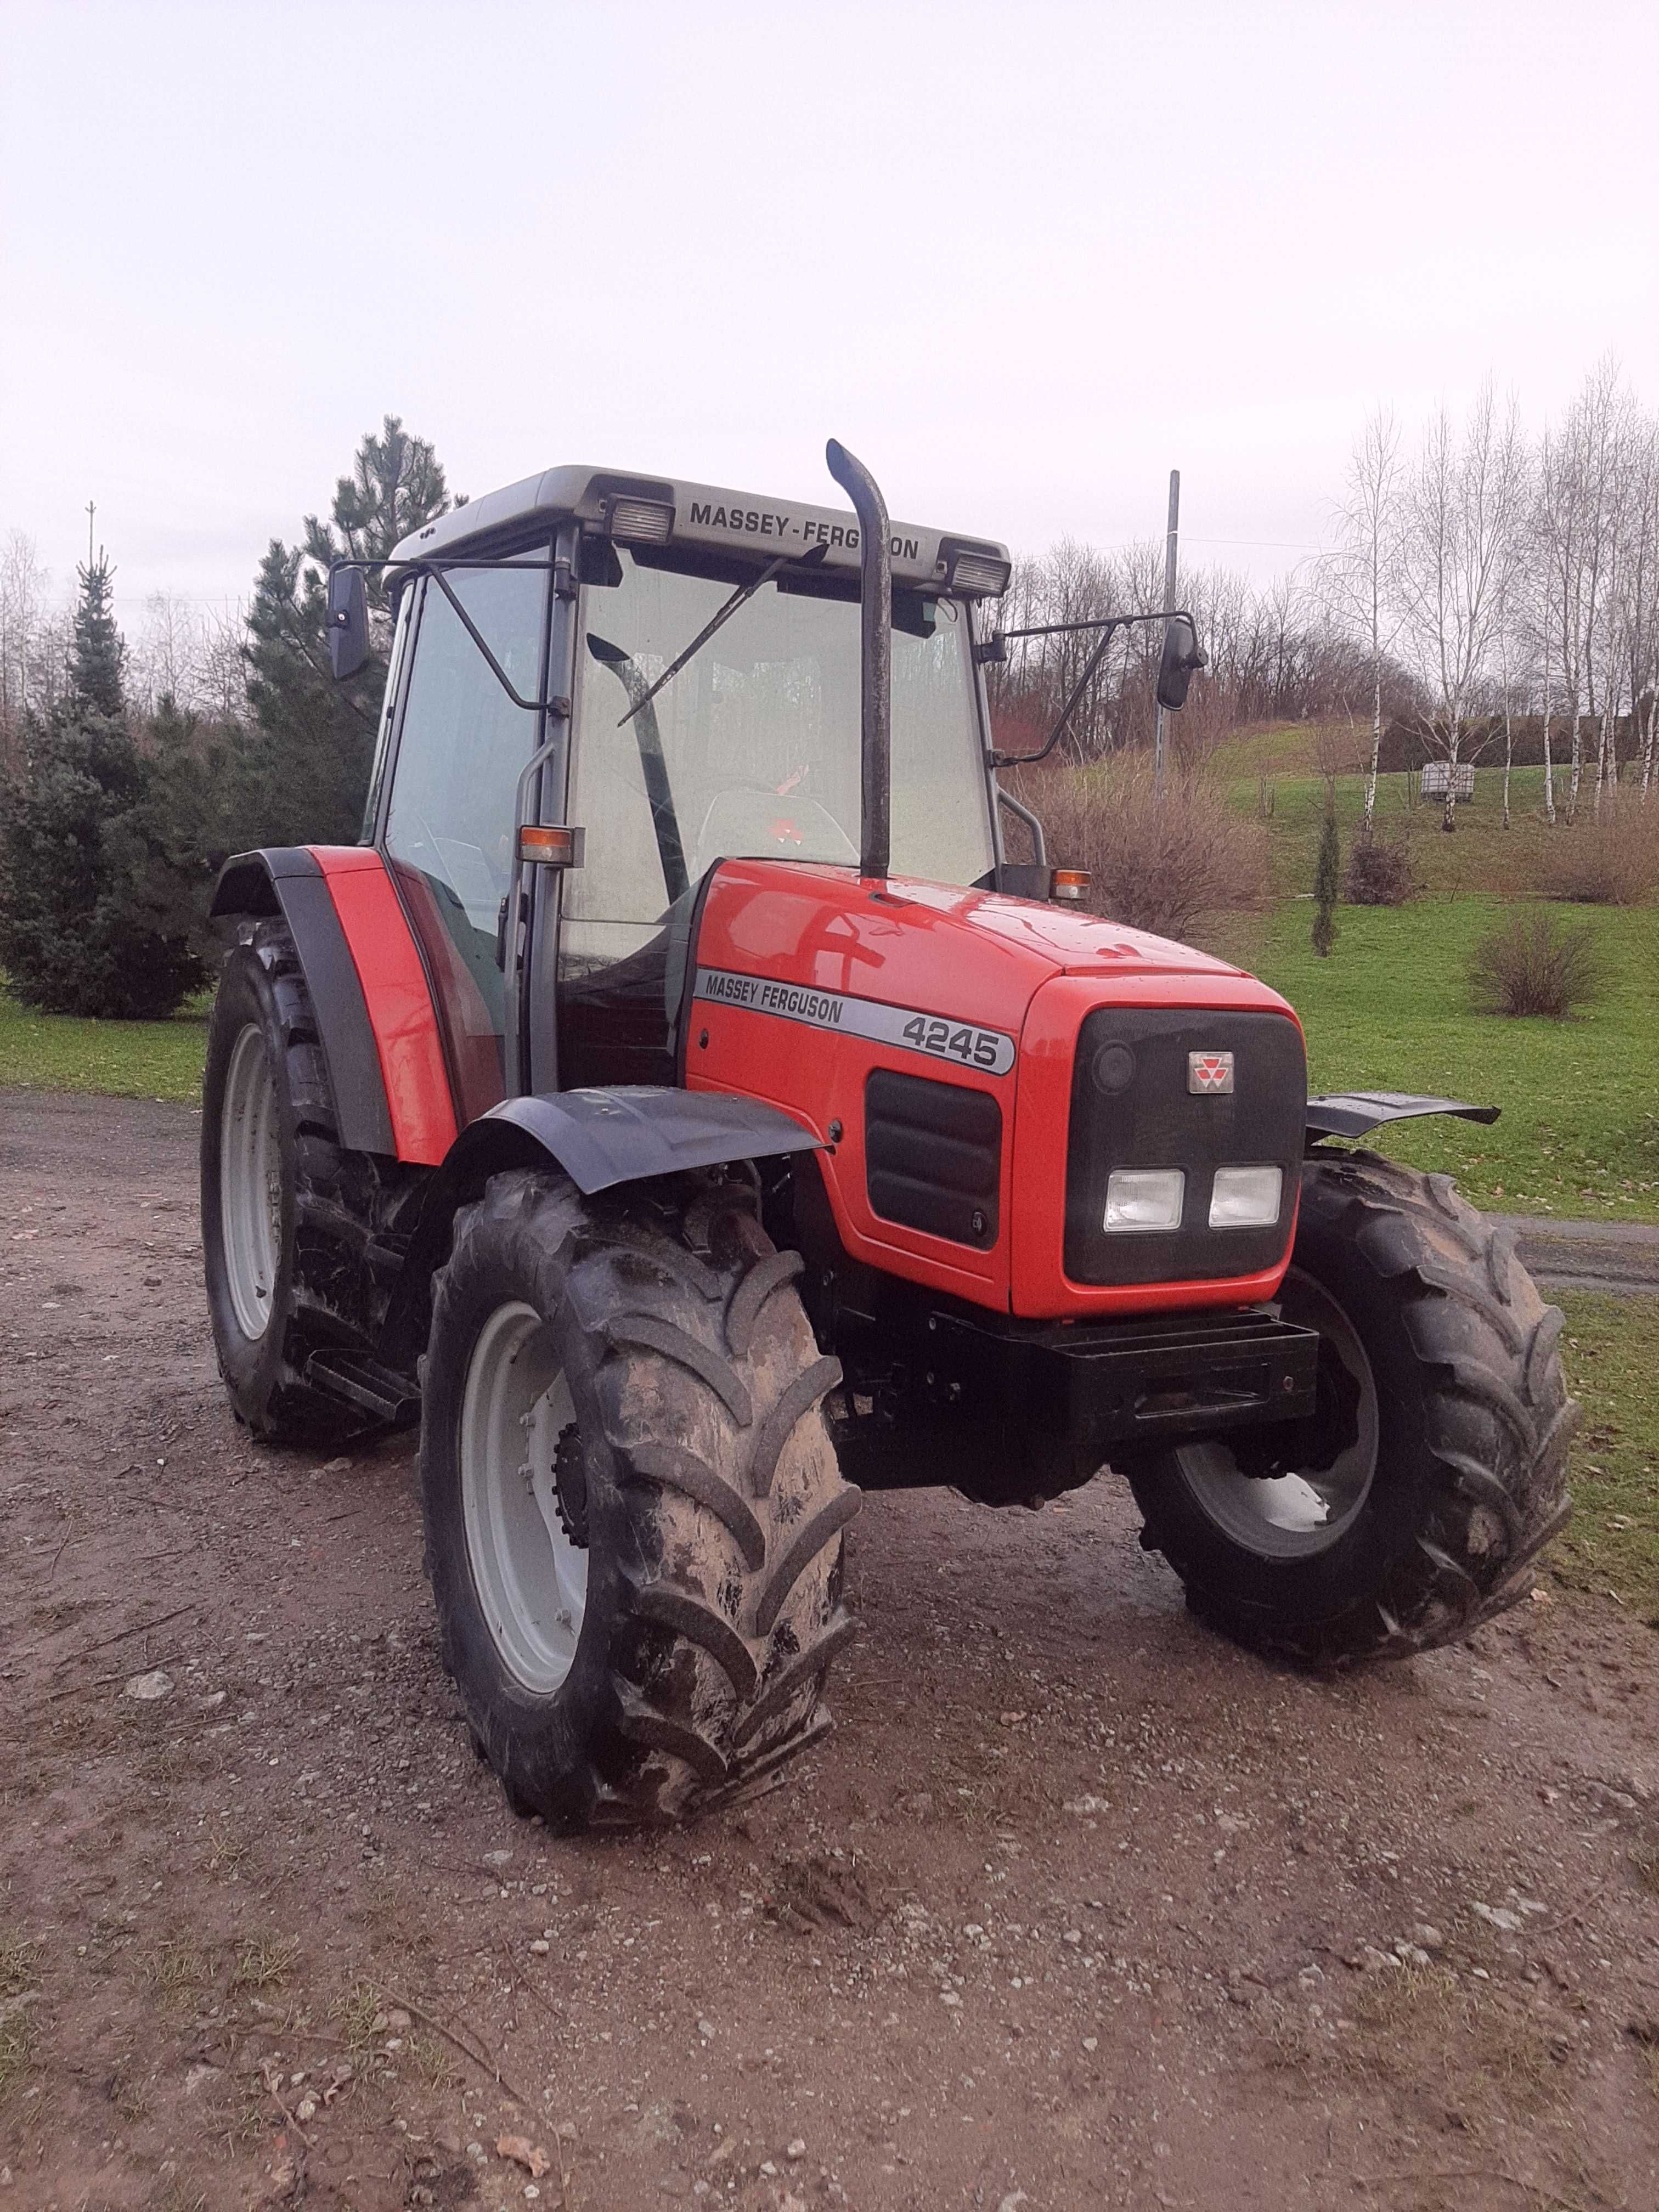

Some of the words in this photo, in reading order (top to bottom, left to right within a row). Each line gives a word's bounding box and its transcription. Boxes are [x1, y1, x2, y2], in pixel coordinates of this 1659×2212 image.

[690, 503, 919, 560] MASSEY-FERGON
[706, 975, 759, 1003] MASSEY
[760, 985, 843, 1023] FERGUSON
[902, 1017, 1000, 1066] 4245
